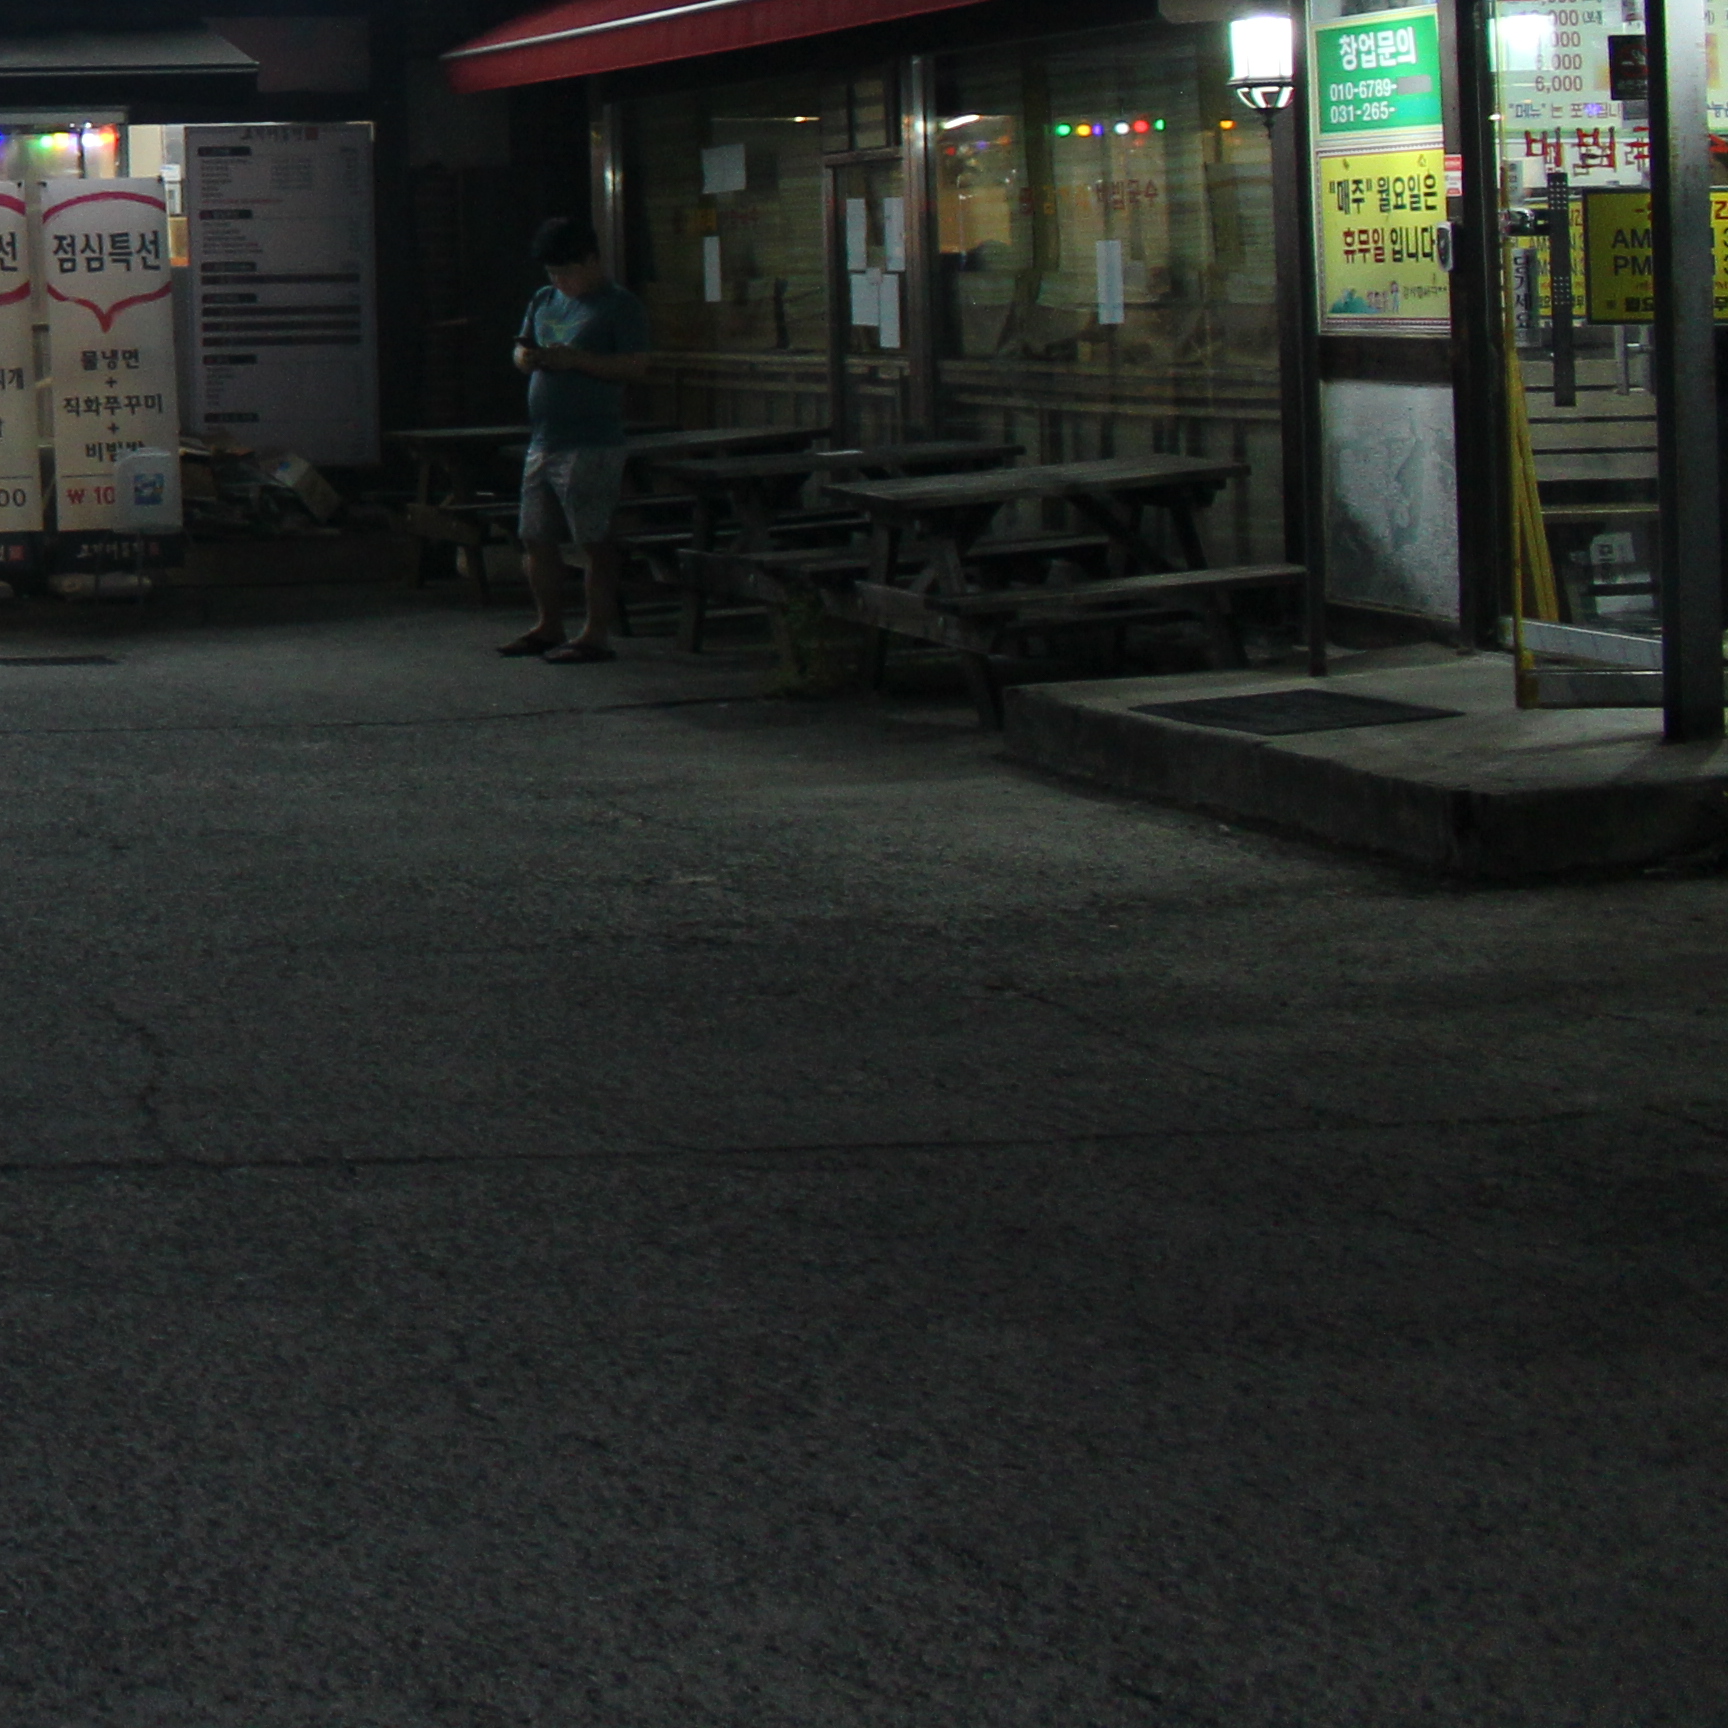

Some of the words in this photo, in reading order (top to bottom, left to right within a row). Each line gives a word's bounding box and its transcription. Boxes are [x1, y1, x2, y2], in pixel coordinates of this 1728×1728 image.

[1339, 26, 1417, 71] 창업문의
[1535, 75, 1583, 93] 6,000
[1377, 172, 1438, 214] 월요일은
[53, 231, 161, 274] 점심특선
[1343, 227, 1385, 264] 휴무일
[1390, 226, 1438, 263] 입니다
[82, 349, 140, 371] 물냉면
